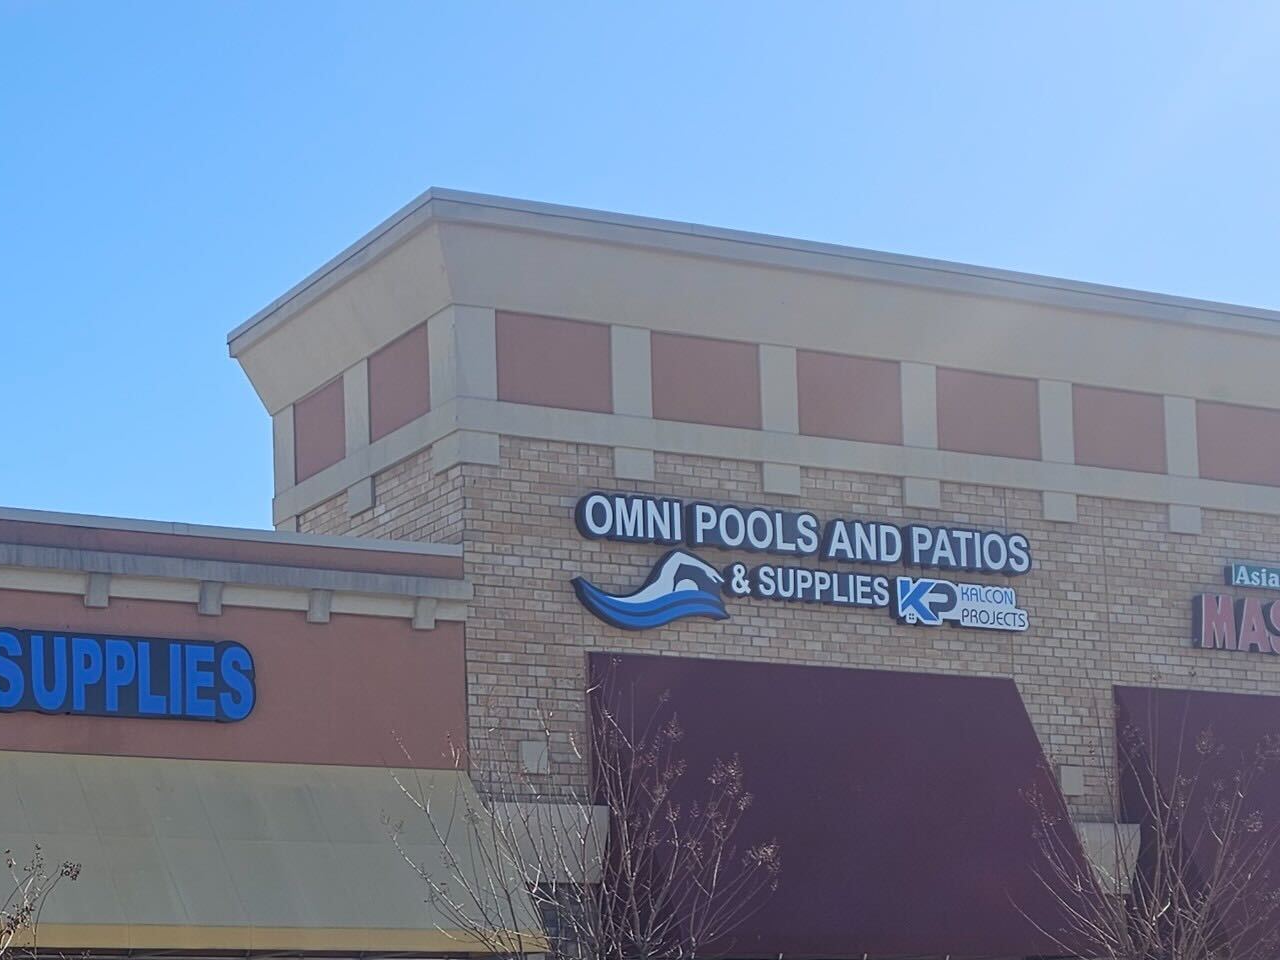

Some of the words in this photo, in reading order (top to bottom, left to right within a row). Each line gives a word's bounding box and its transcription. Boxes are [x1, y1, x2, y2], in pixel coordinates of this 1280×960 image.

[585, 495, 682, 541] OMNI
[696, 504, 819, 553] POOLS
[828, 520, 903, 563] AND
[912, 526, 1030, 573] PATIOS
[732, 564, 751, 594] &
[759, 566, 890, 607] SUPPLIES
[961, 588, 1014, 605] KALCON
[961, 608, 1026, 628] PROJECTS
